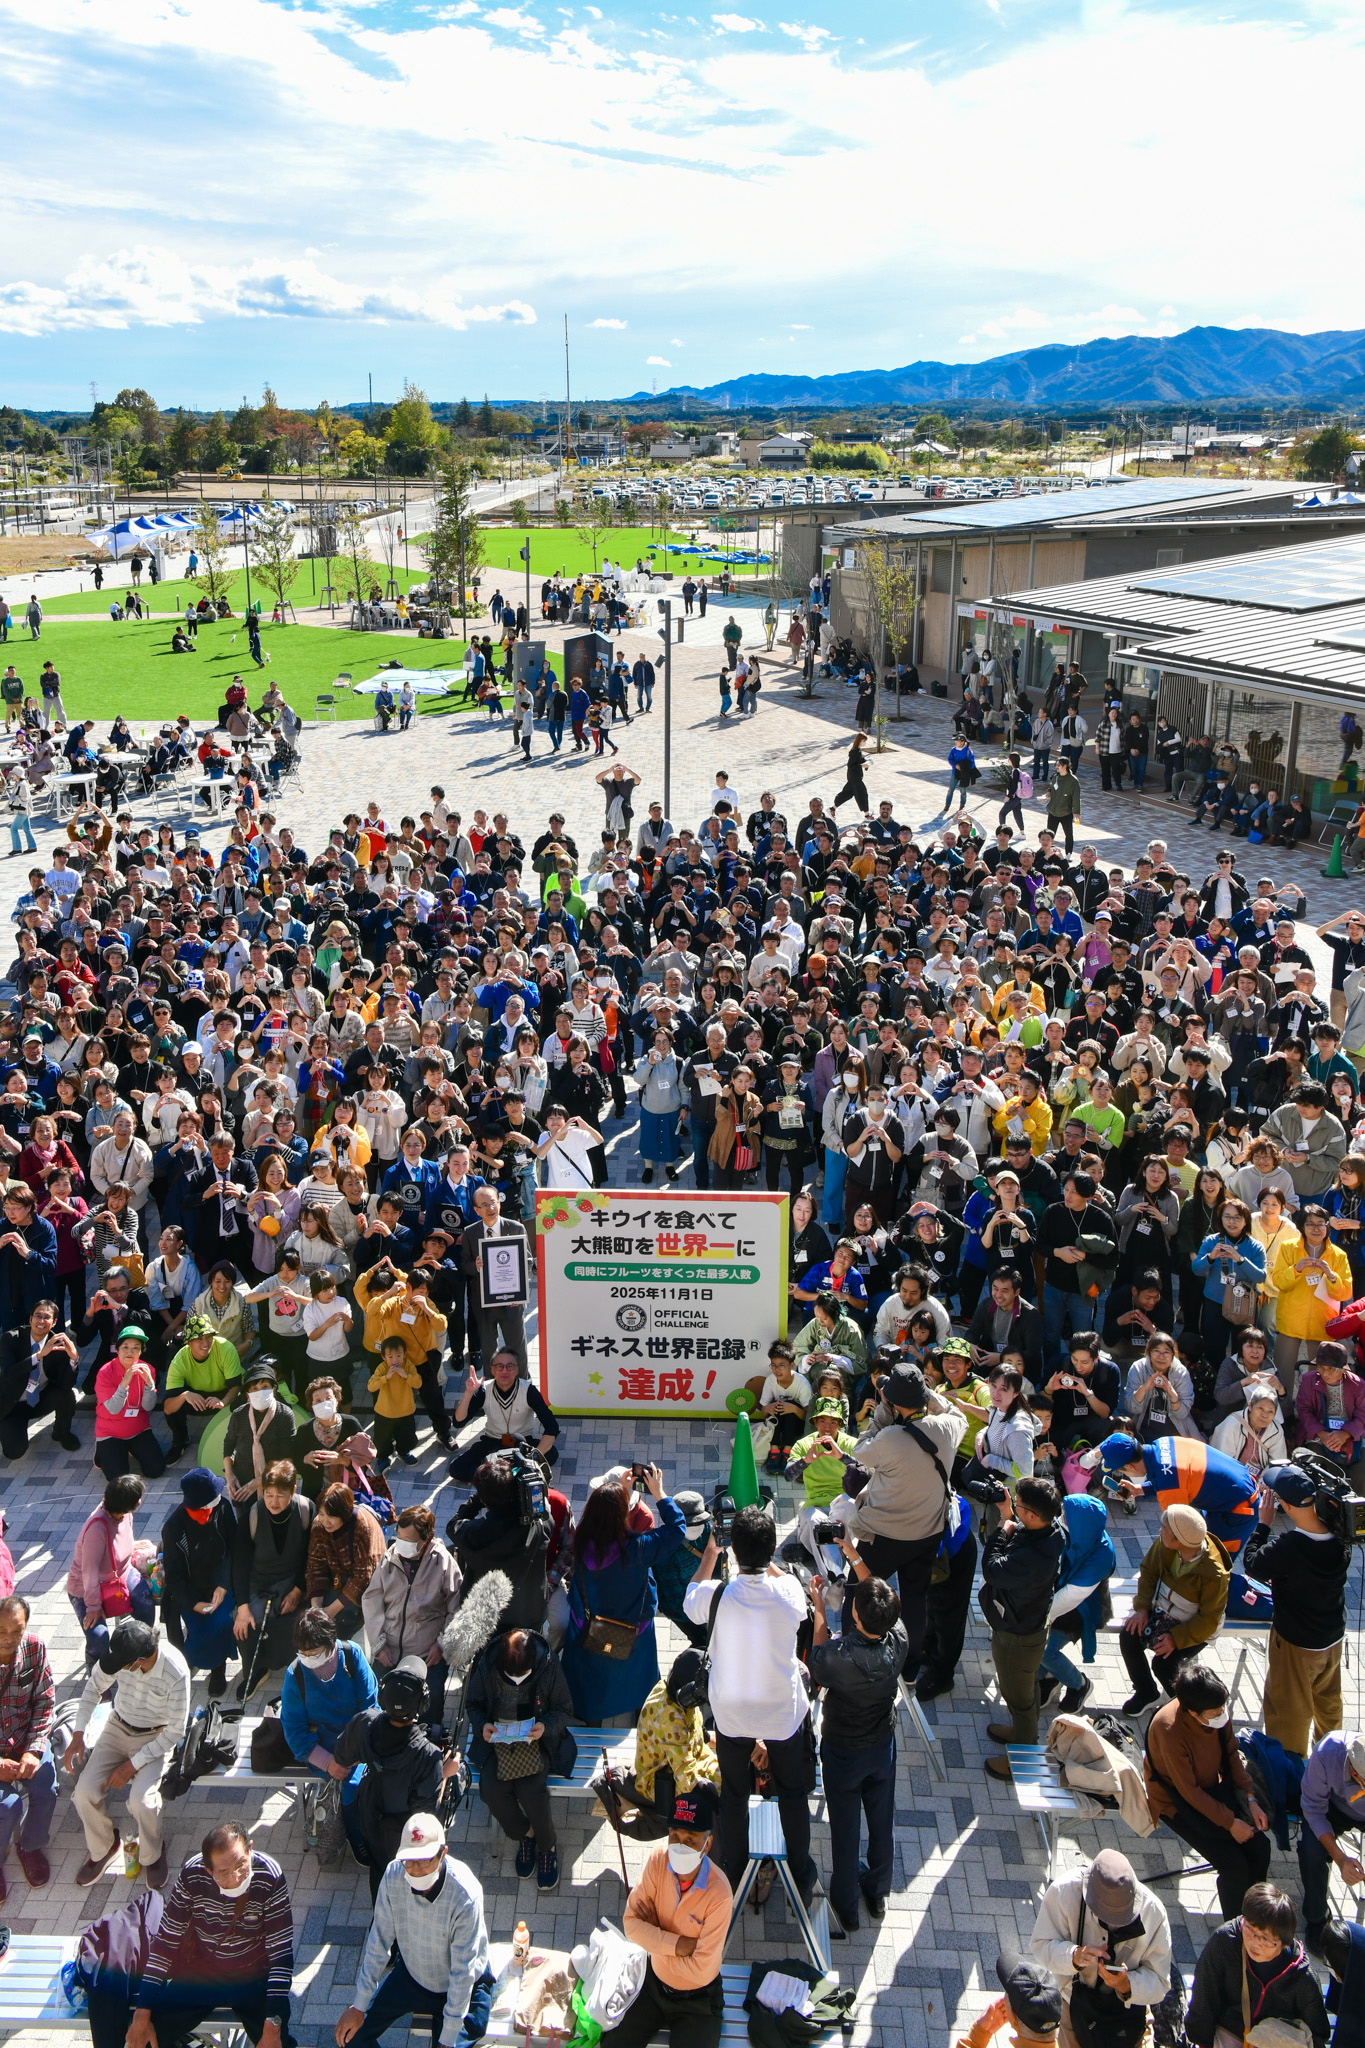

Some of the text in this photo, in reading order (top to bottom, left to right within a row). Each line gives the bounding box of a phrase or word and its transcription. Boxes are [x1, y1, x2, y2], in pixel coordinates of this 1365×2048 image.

[590, 1210, 738, 1230] キウイを食べて
[571, 1233, 756, 1257] 大熊町を世界一に
[574, 1266, 752, 1280] 同時にフルーツをすくった最多人数
[610, 1286, 713, 1300] 2025年11月1日
[654, 1310, 709, 1319] OFFICIAL
[654, 1320, 709, 1328] CHALLENGE
[618, 1368, 716, 1402] 達成！
[1153, 1414, 1164, 1422] 101
